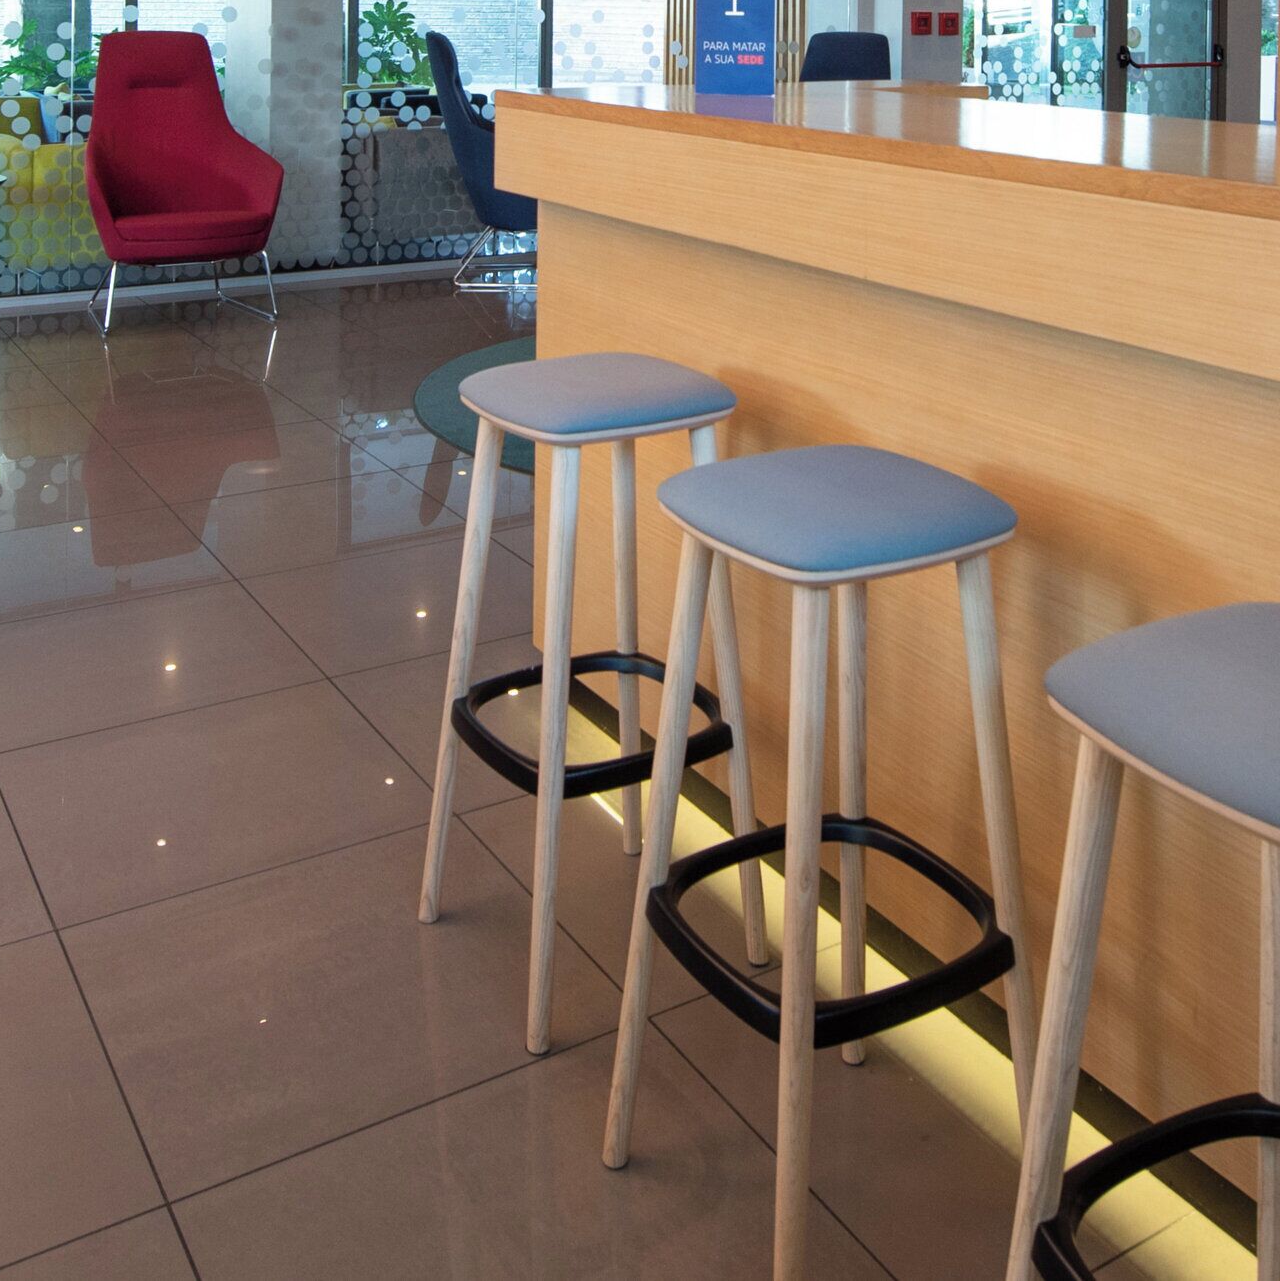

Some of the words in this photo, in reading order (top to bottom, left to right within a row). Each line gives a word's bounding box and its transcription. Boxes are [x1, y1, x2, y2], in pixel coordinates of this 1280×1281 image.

[703, 40, 730, 52] PARA
[732, 41, 766, 53] MATAR
[704, 54, 712, 64] A
[714, 54, 734, 65] SUA
[737, 55, 764, 65] SEDE
